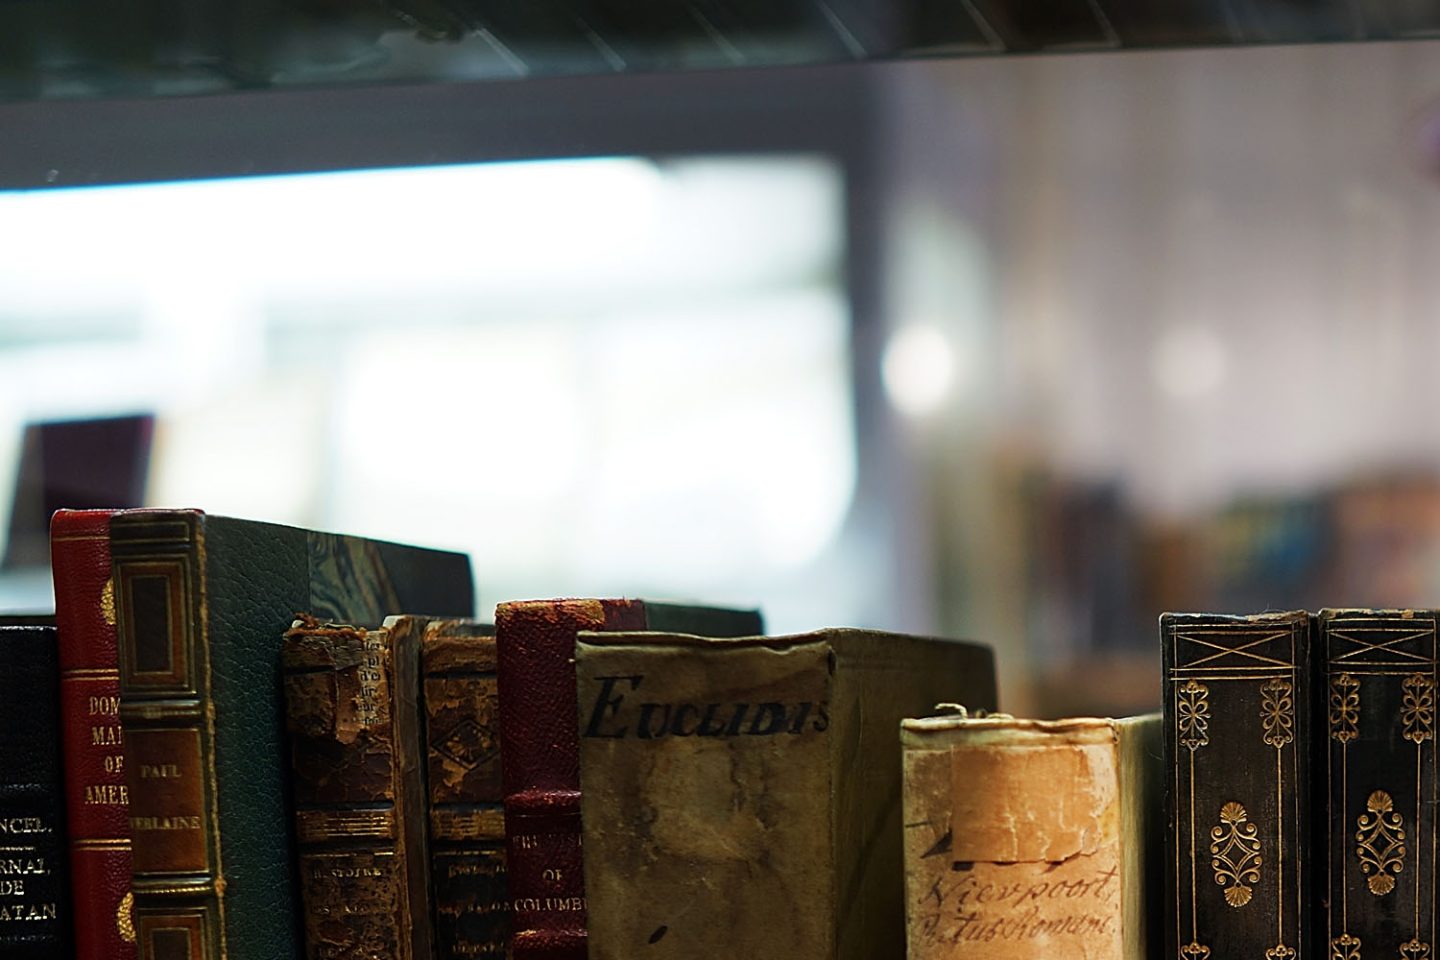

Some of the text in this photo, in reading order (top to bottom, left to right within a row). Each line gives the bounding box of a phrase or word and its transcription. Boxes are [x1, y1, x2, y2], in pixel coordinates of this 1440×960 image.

[104, 755, 124, 773] OF
[140, 765, 182, 778] PAUL
[0, 880, 25, 895] DE
